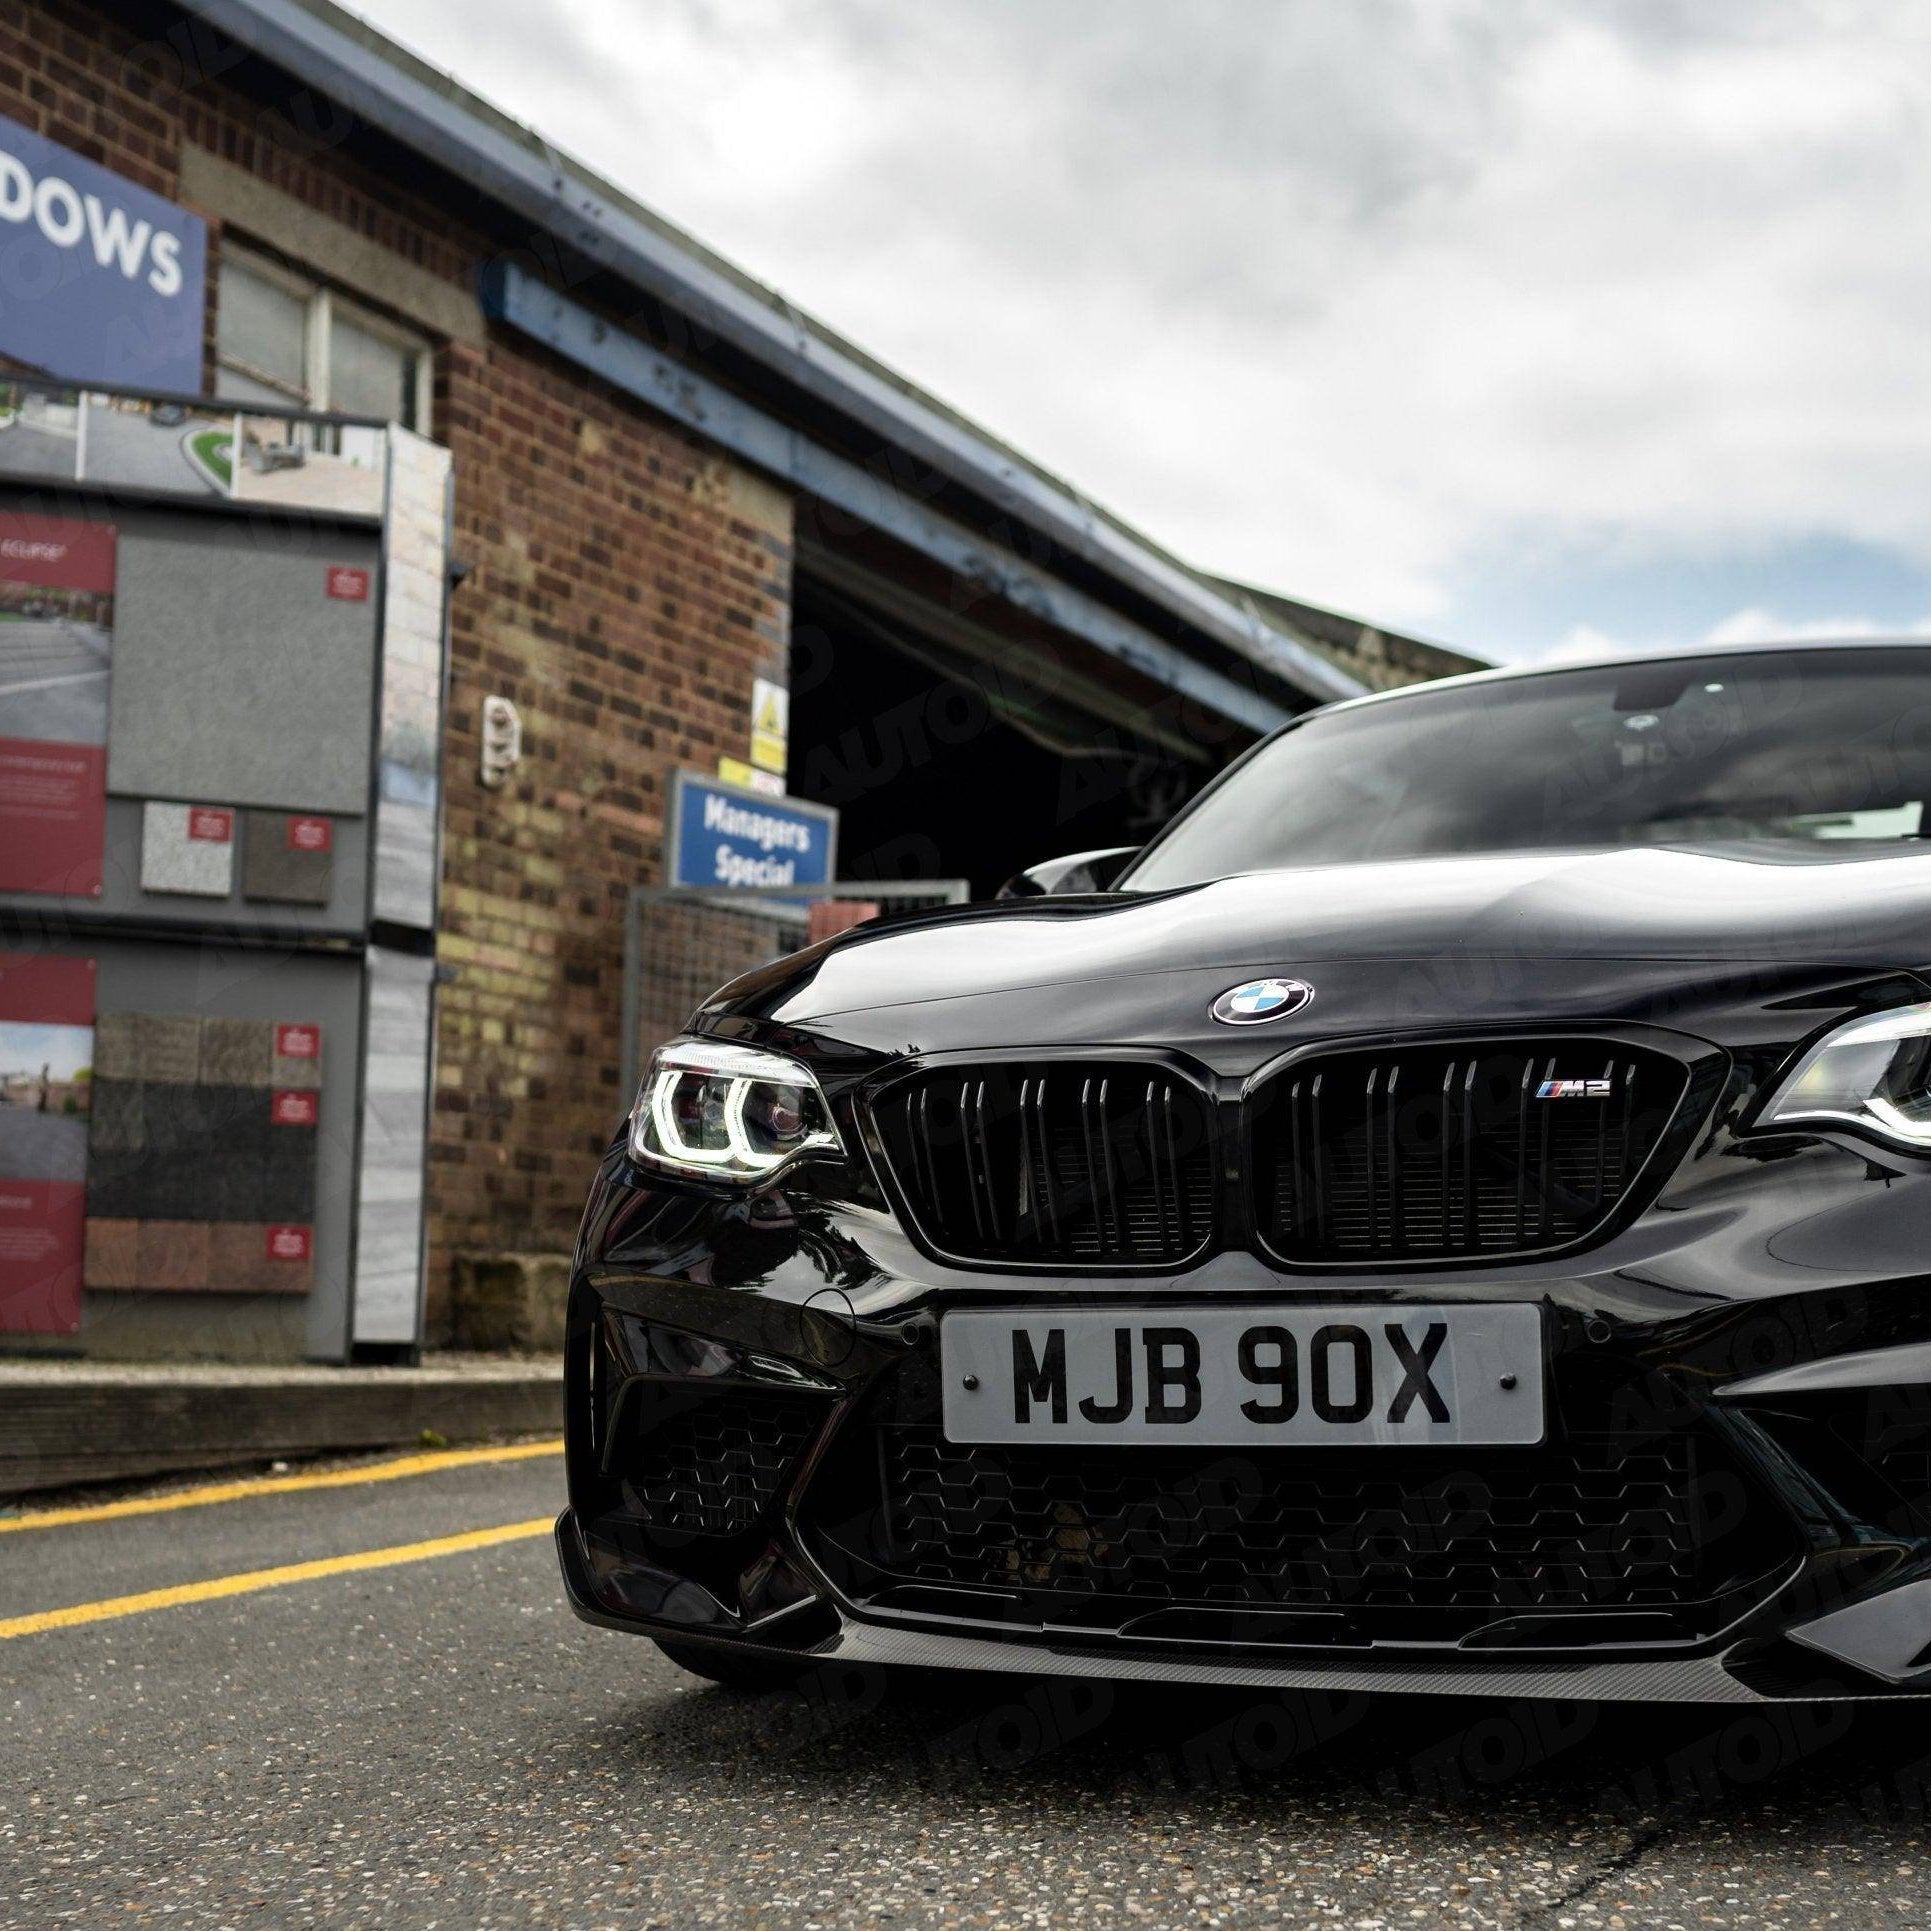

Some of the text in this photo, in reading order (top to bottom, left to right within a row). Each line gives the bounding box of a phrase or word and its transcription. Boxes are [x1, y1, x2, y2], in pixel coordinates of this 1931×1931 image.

[0, 151, 183, 297] DOWS
[704, 793, 810, 853] Managers
[715, 844, 795, 889] Special
[1556, 1080, 1611, 1097] M2
[1011, 1323, 1451, 1425] MJB 90X
